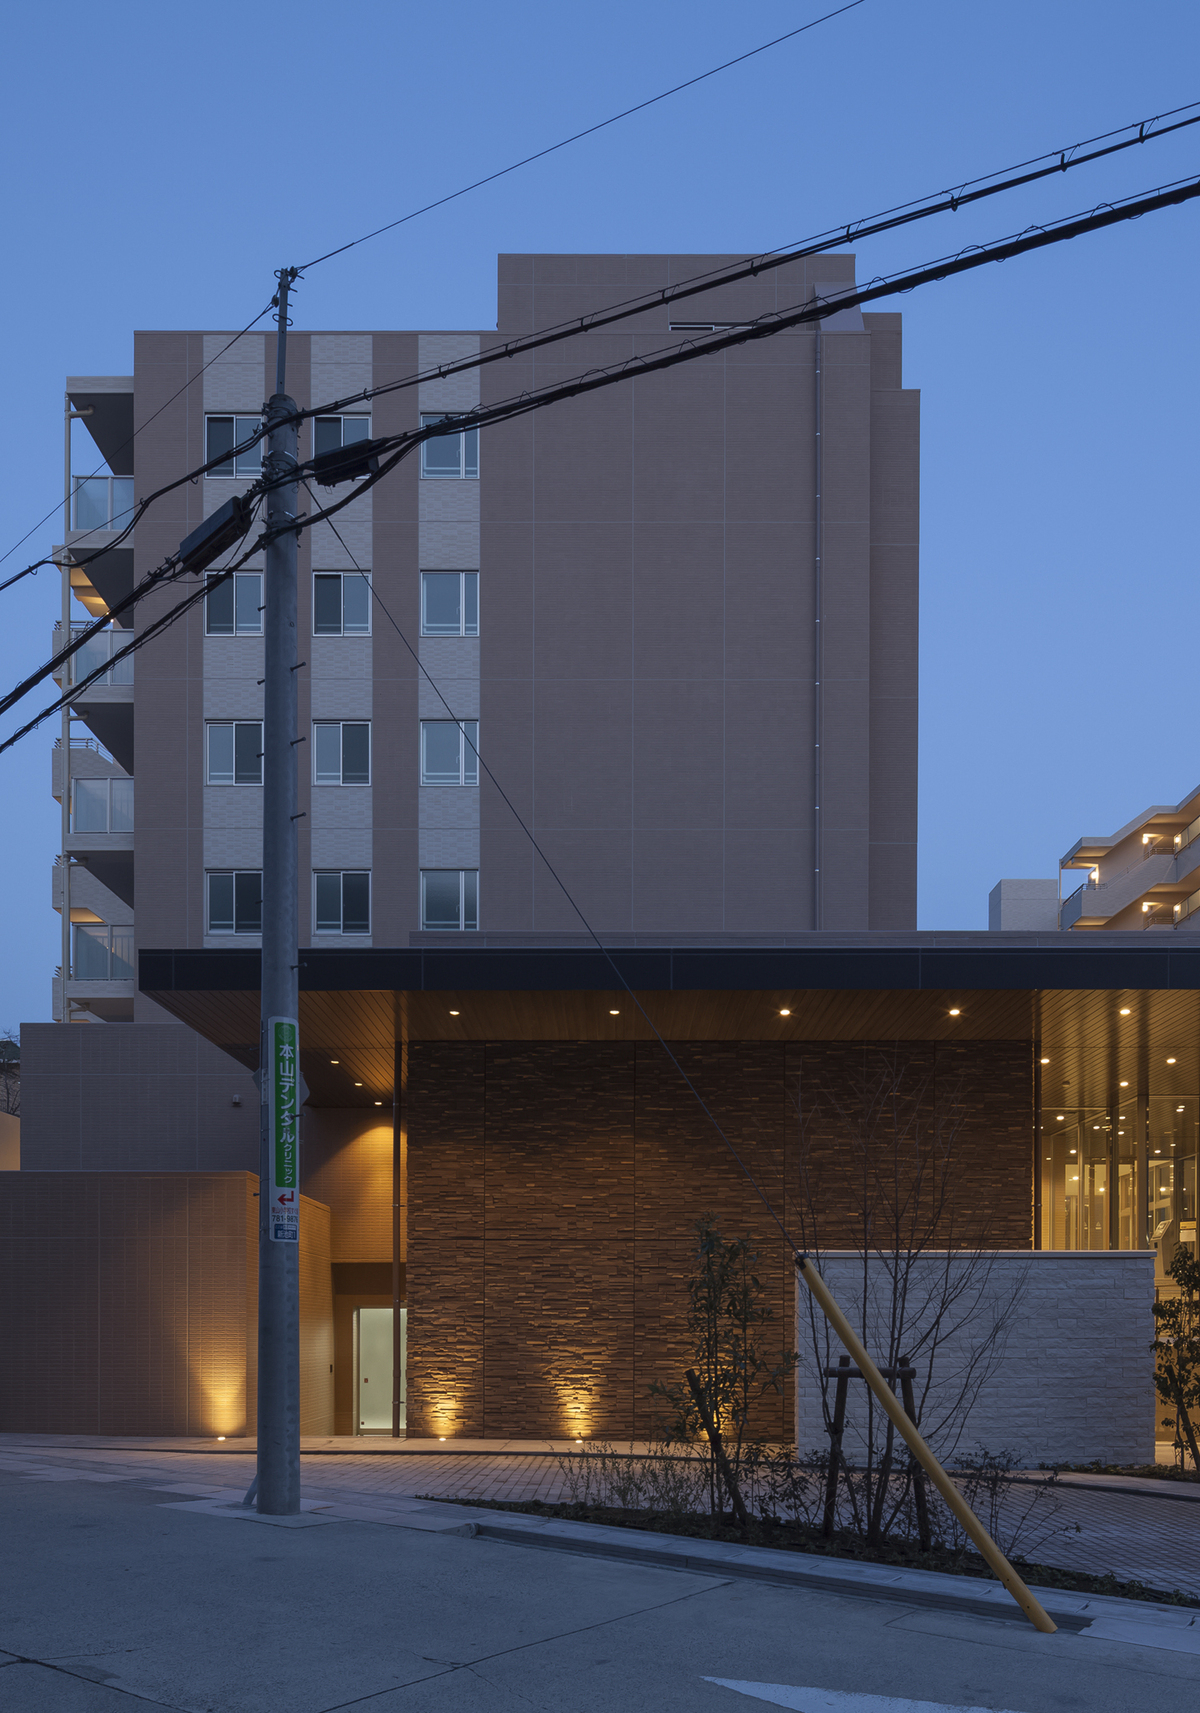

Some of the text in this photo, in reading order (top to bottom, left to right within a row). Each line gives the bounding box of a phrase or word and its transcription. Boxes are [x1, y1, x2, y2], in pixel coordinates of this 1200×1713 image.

[279, 1043, 295, 1184] 本山デンタルクリニック
